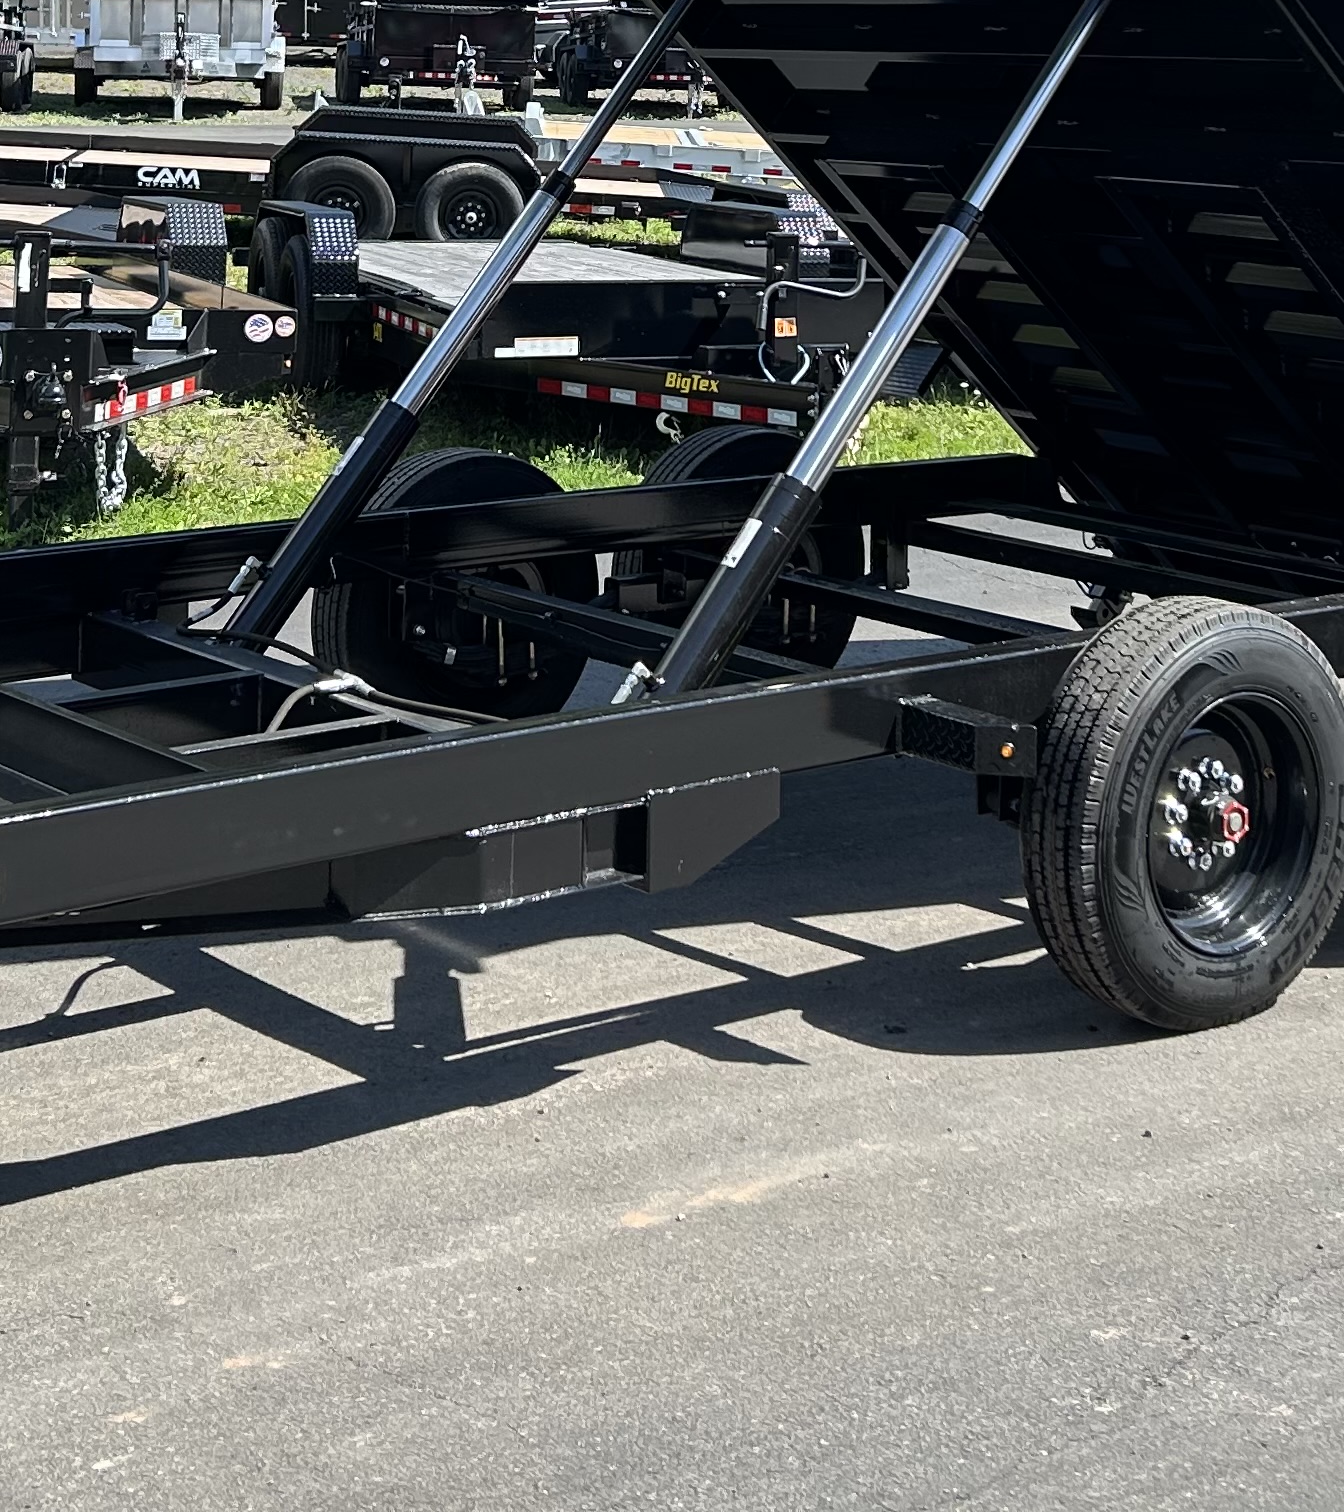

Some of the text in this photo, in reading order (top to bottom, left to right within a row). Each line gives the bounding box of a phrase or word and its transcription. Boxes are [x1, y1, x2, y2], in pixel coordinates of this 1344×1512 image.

[137, 166, 201, 186] CAM
[664, 371, 720, 394] BigTex
[1120, 689, 1183, 816] WESTLAKE
